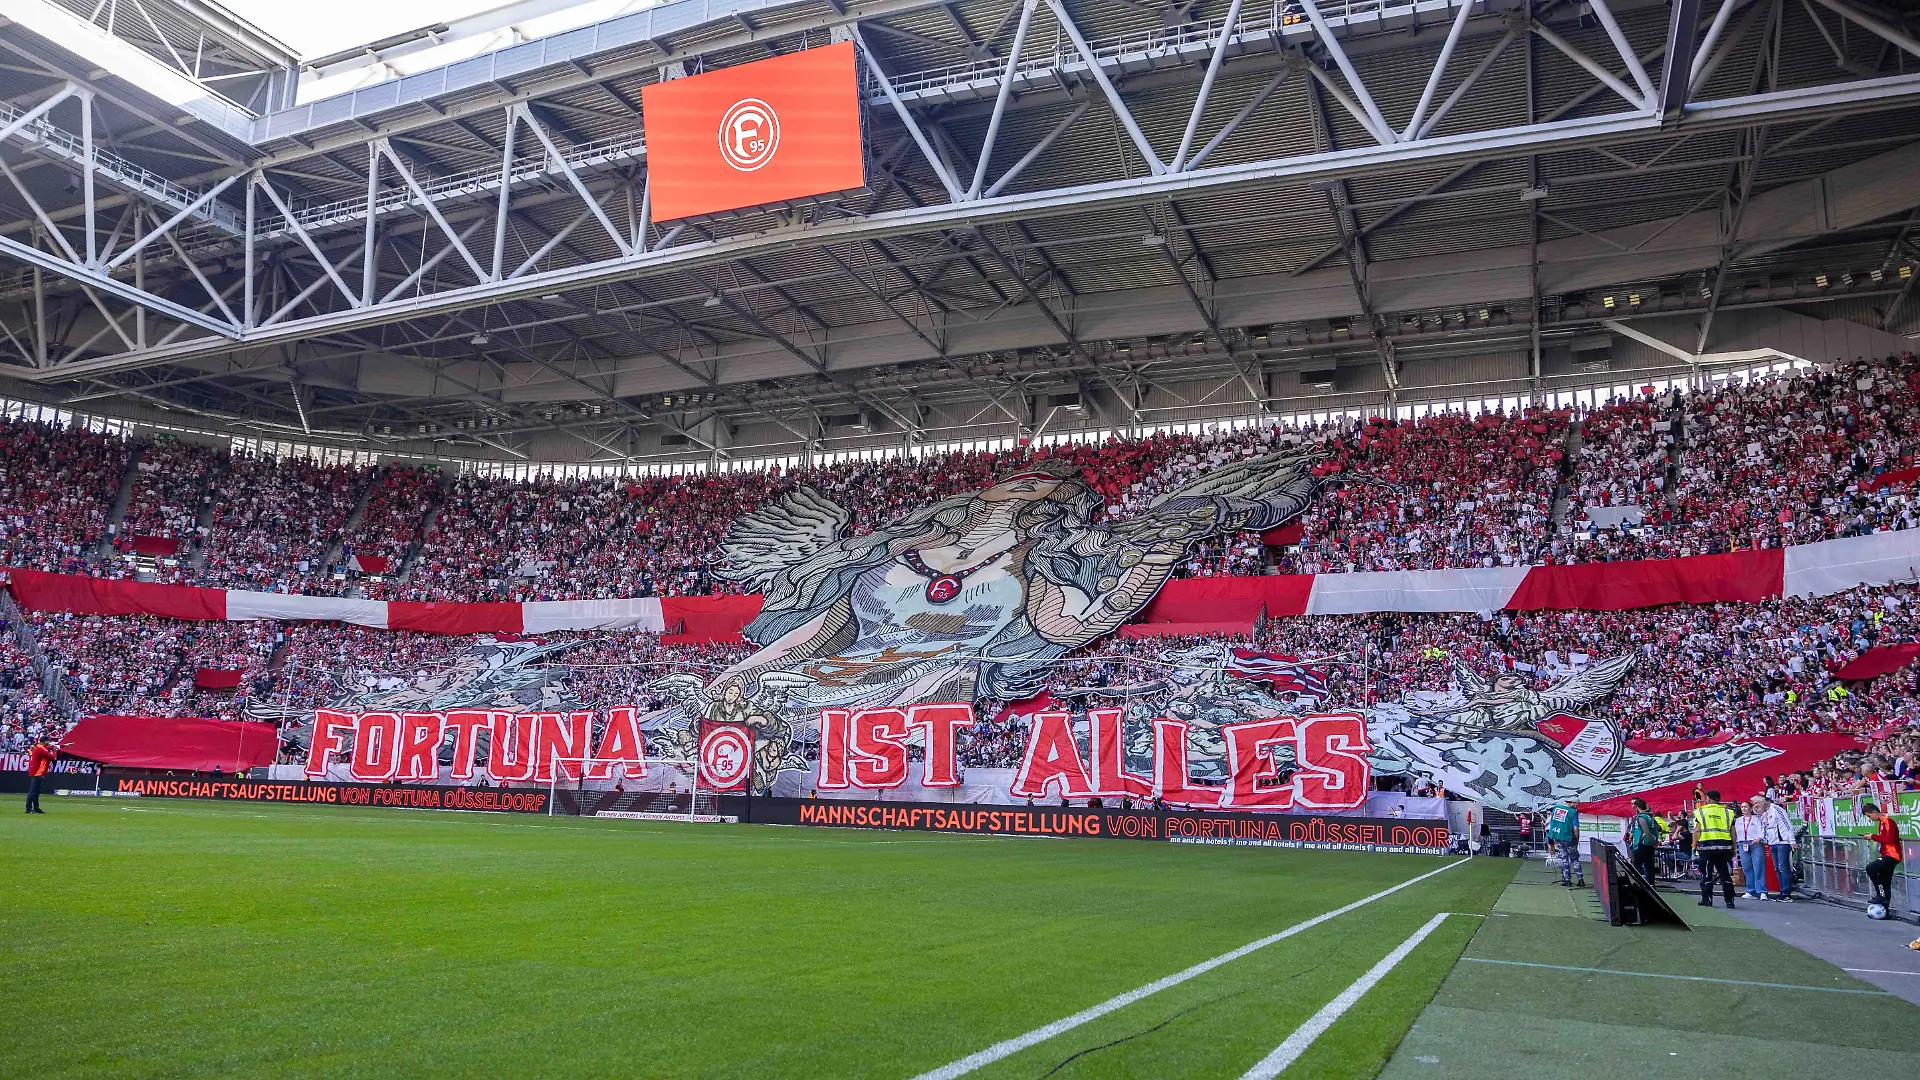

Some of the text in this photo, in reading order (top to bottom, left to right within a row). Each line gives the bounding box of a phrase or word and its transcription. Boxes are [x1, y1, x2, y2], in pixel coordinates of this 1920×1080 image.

[749, 139, 765, 153] 95
[1568, 725, 1604, 759] FORTUNA
[304, 702, 1374, 812] FORTUNA IST ALLES
[721, 760, 733, 771] 95
[118, 779, 546, 812] MANNSCHAFTSAUFSTELLUNG VON FORTUNA DÜSSELDORF
[800, 804, 1101, 834] MANNSCHAFTSAUFSTELLUNG
[1107, 815, 1157, 838] VON
[1165, 817, 1281, 841] FORTUNA
[1205, 837, 1227, 845] hotels
[1273, 840, 1295, 848] hotels
[1343, 843, 1366, 851] hotels
[1416, 847, 1440, 855] hotels
